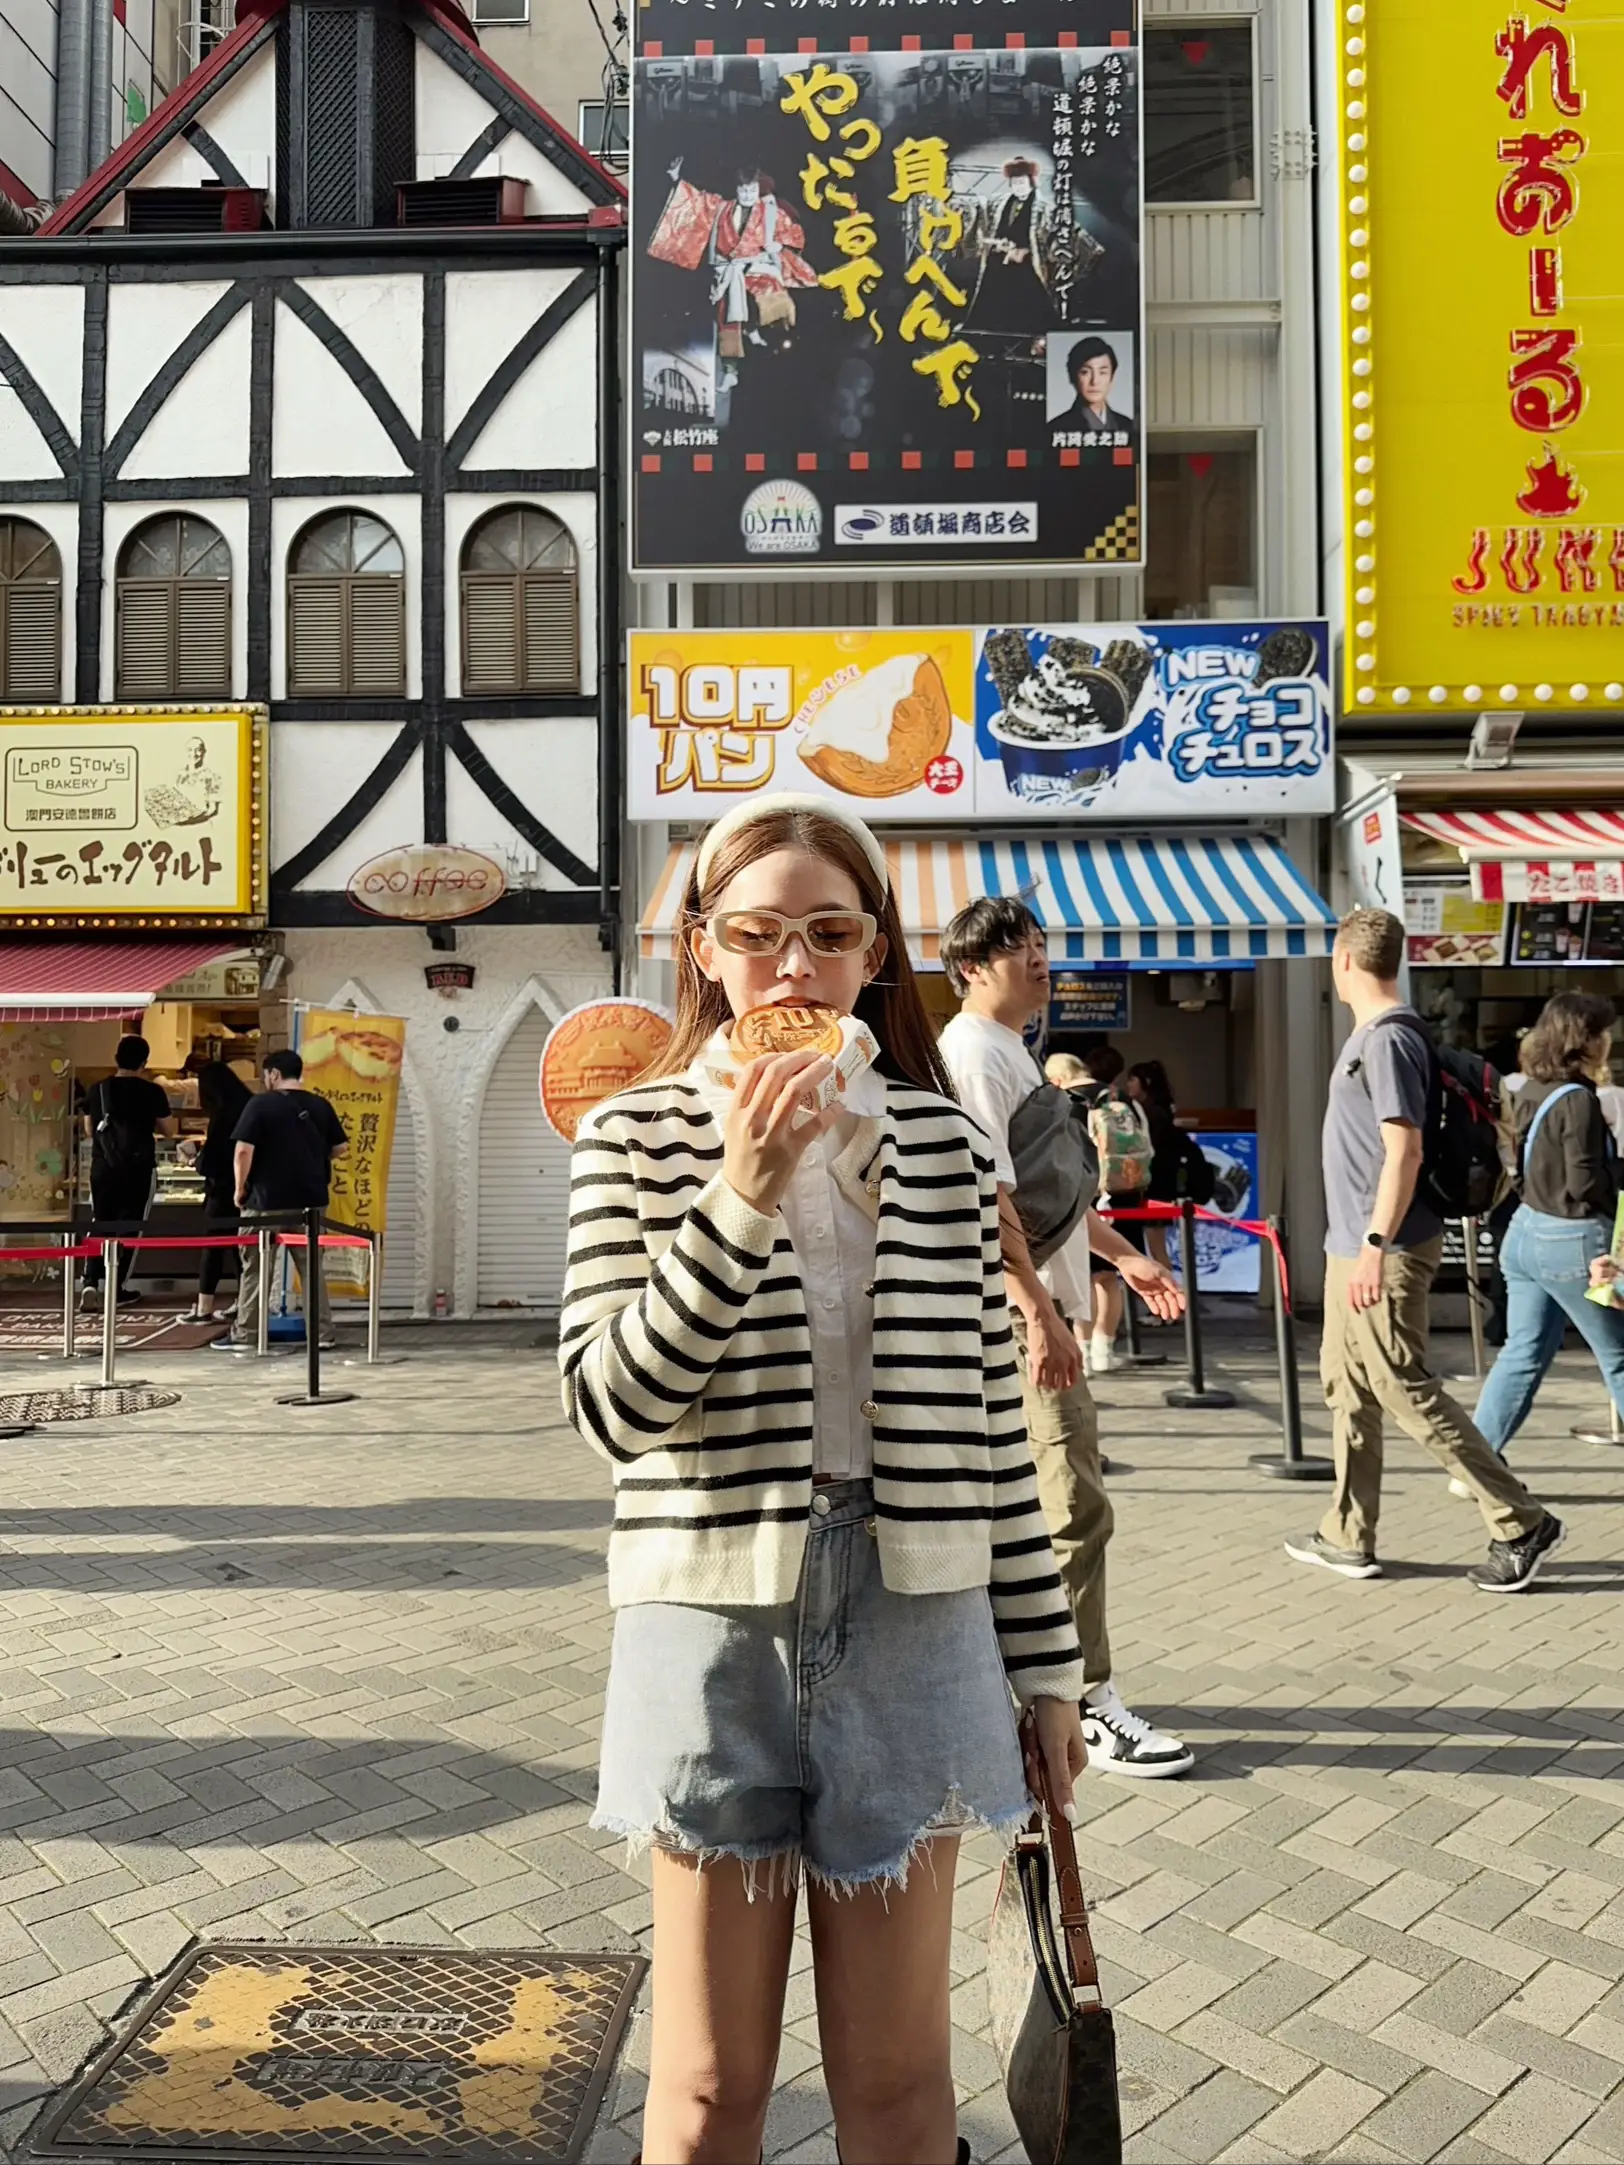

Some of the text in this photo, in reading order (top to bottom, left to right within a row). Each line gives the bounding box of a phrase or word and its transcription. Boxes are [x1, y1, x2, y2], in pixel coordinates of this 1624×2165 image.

[1077, 75, 1099, 157] 絶景かな
[1102, 55, 1123, 138] 絶景かな
[1494, 0, 1590, 434] れおーる
[744, 504, 818, 534] OSAKA
[889, 511, 1030, 536] 道頓堀商店会
[1165, 648, 1257, 687] NEW
[641, 664, 795, 732] 10円
[1206, 686, 1313, 732] チョコ
[18, 756, 125, 776] LORD STOW'S
[656, 727, 776, 795] パン
[1178, 730, 1321, 774] チュロス
[46, 779, 98, 790] BAKERY
[1021, 776, 1070, 793] NEW
[364, 867, 488, 896] coffee
[1530, 873, 1619, 894] たこ焼き
